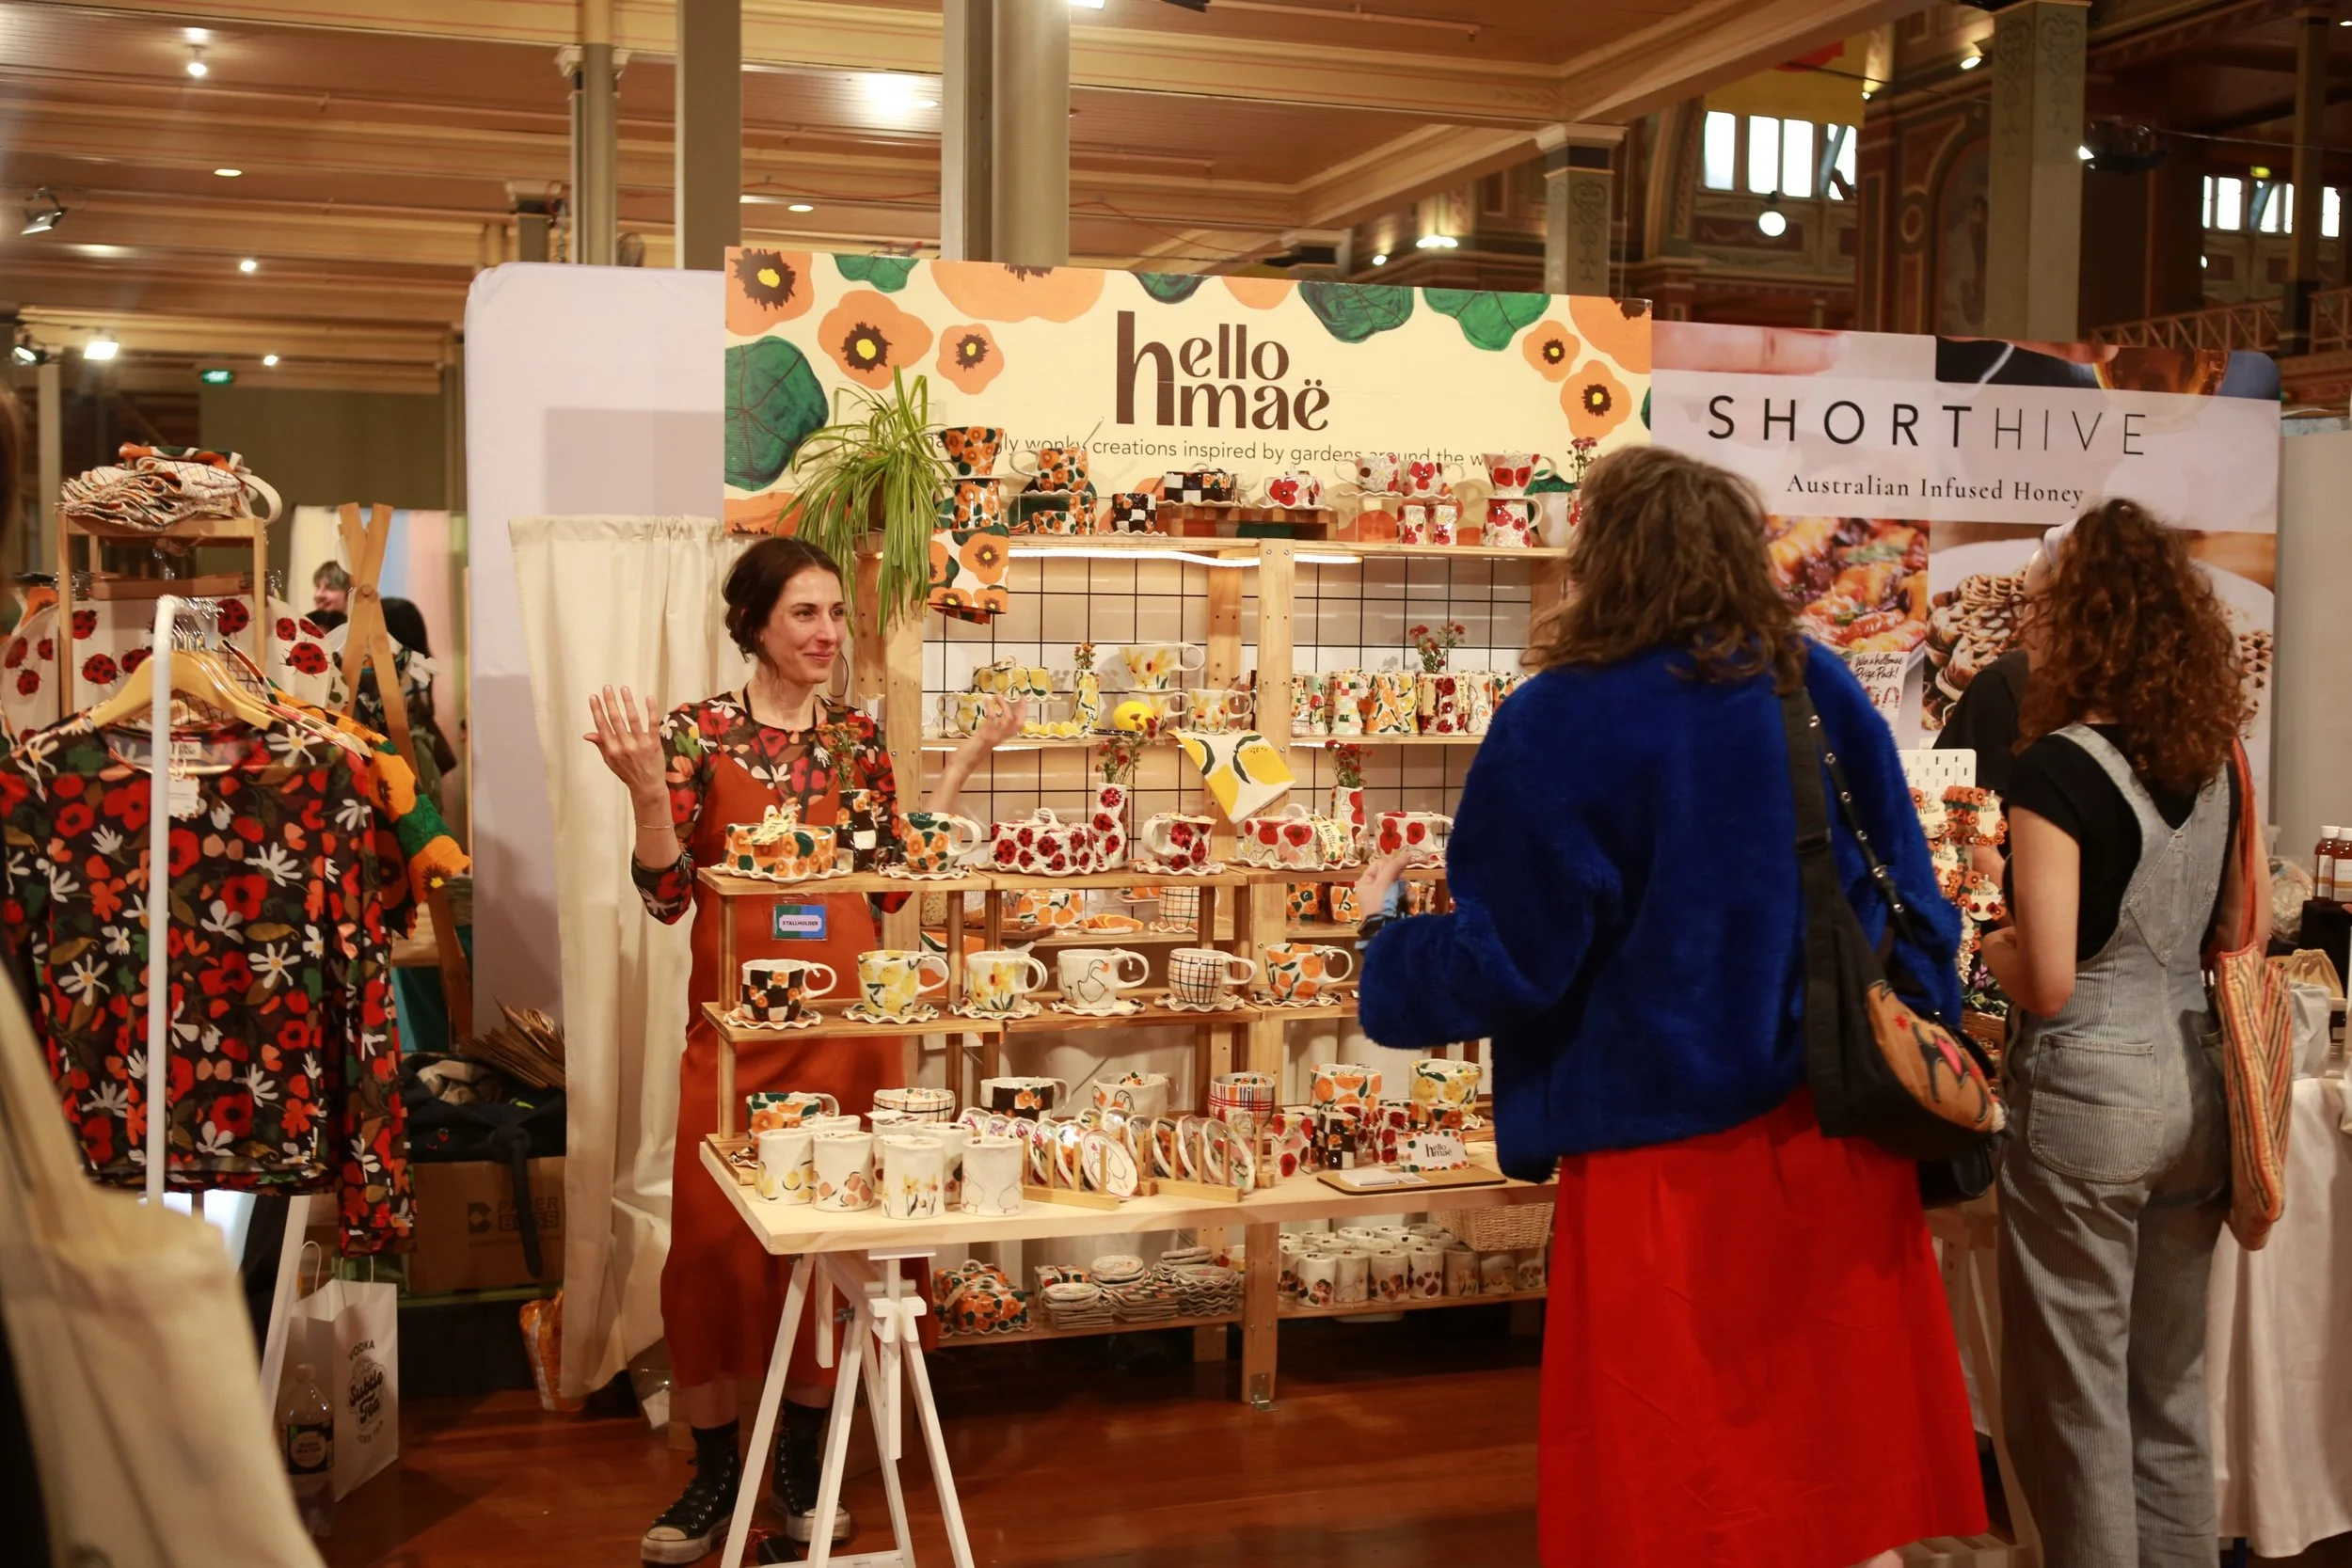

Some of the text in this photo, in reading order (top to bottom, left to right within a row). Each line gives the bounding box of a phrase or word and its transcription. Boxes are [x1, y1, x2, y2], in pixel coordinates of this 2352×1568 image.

[1116, 309, 1290, 426] hello
[1180, 378, 1330, 432] maë
[1707, 394, 2146, 456] SHORTHIVE
[1092, 438, 1177, 456] creations
[1184, 440, 1257, 463] inspired
[1263, 442, 1285, 465] by
[1290, 445, 1362, 466] gardens
[1436, 447, 1464, 463] the
[1786, 474, 2084, 510] Australian Infused Honey
[1876, 666, 1899, 681] Pack!
[1424, 1143, 1447, 1158] hello
[498, 1196, 559, 1215] PAER
[347, 1338, 375, 1361] VODKA
